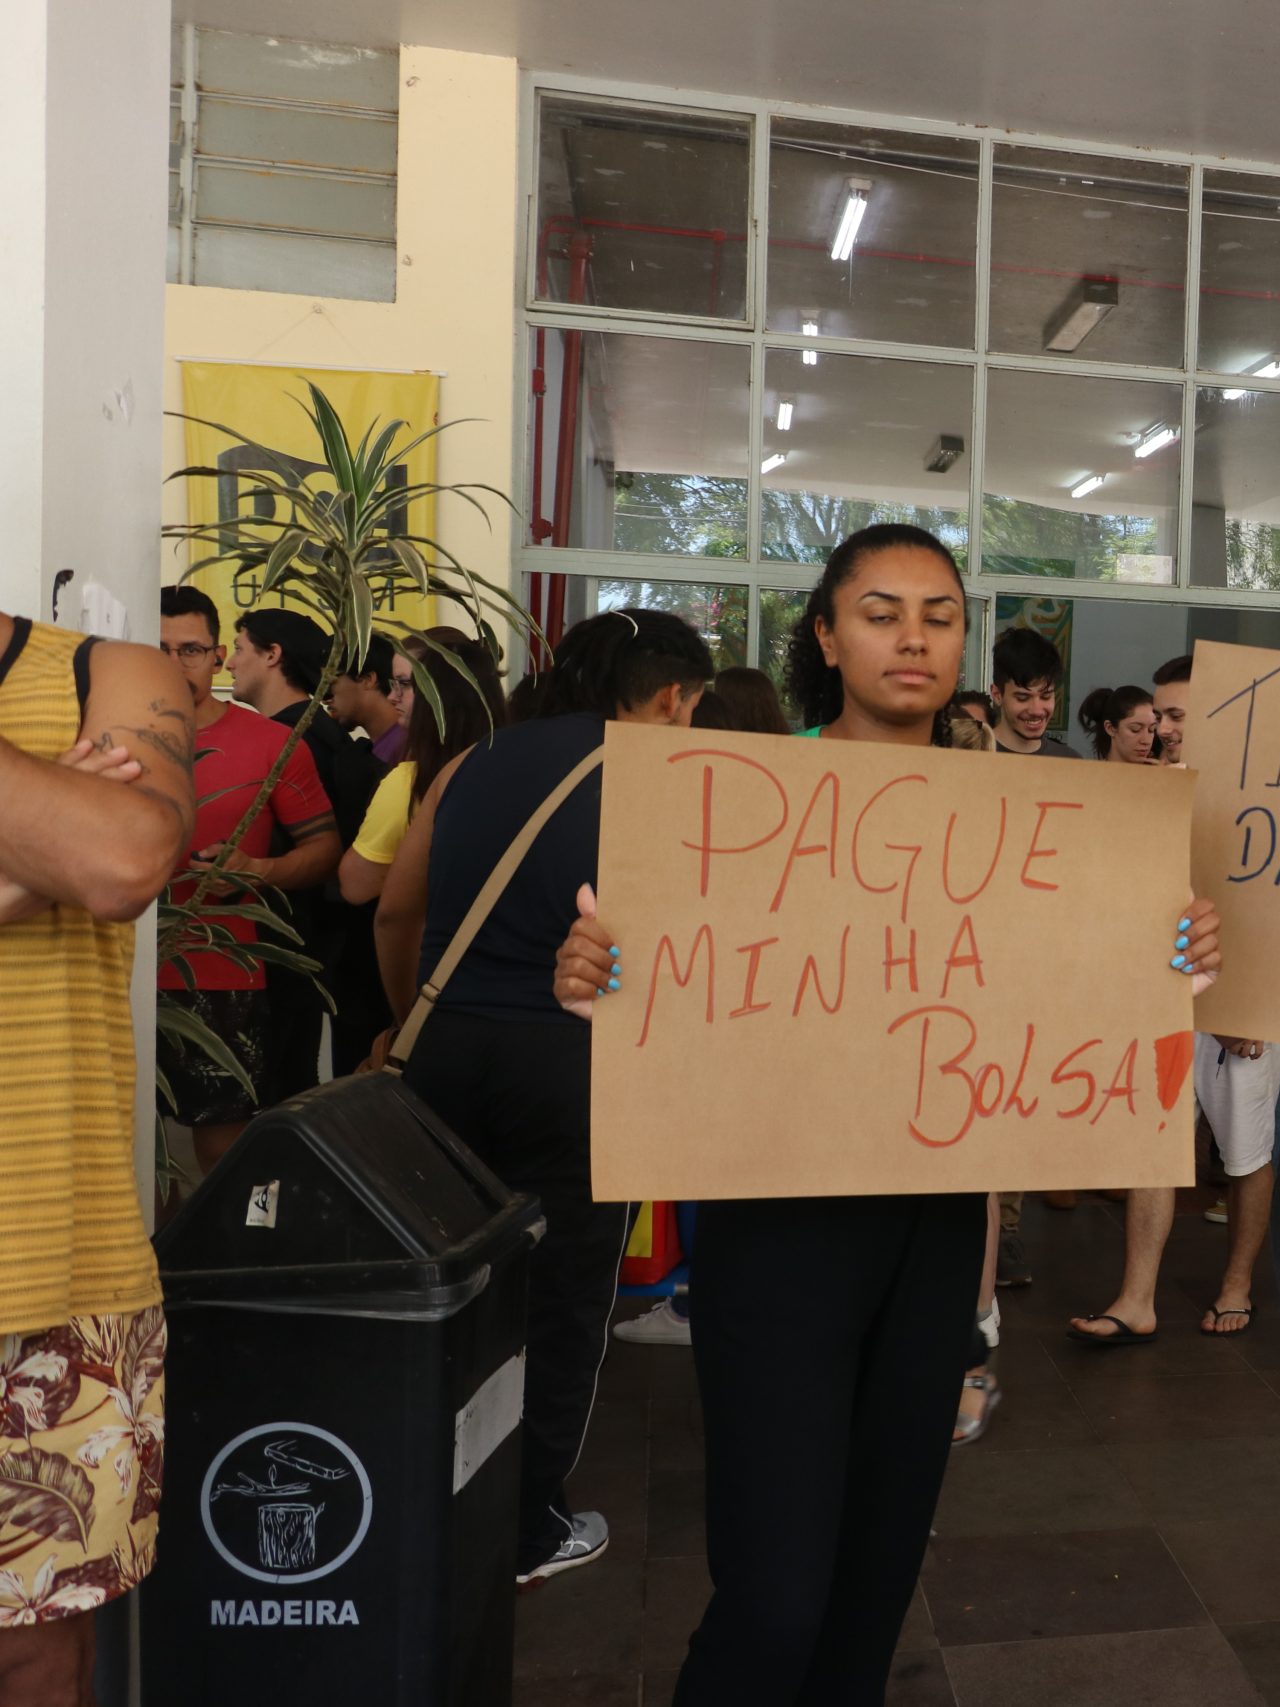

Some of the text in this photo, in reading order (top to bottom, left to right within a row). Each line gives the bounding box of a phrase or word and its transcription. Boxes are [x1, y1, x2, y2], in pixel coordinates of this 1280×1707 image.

[667, 749, 1084, 922] PAGUE
[635, 914, 986, 1047] MINHA
[210, 1599, 361, 1626] MADEIRA
